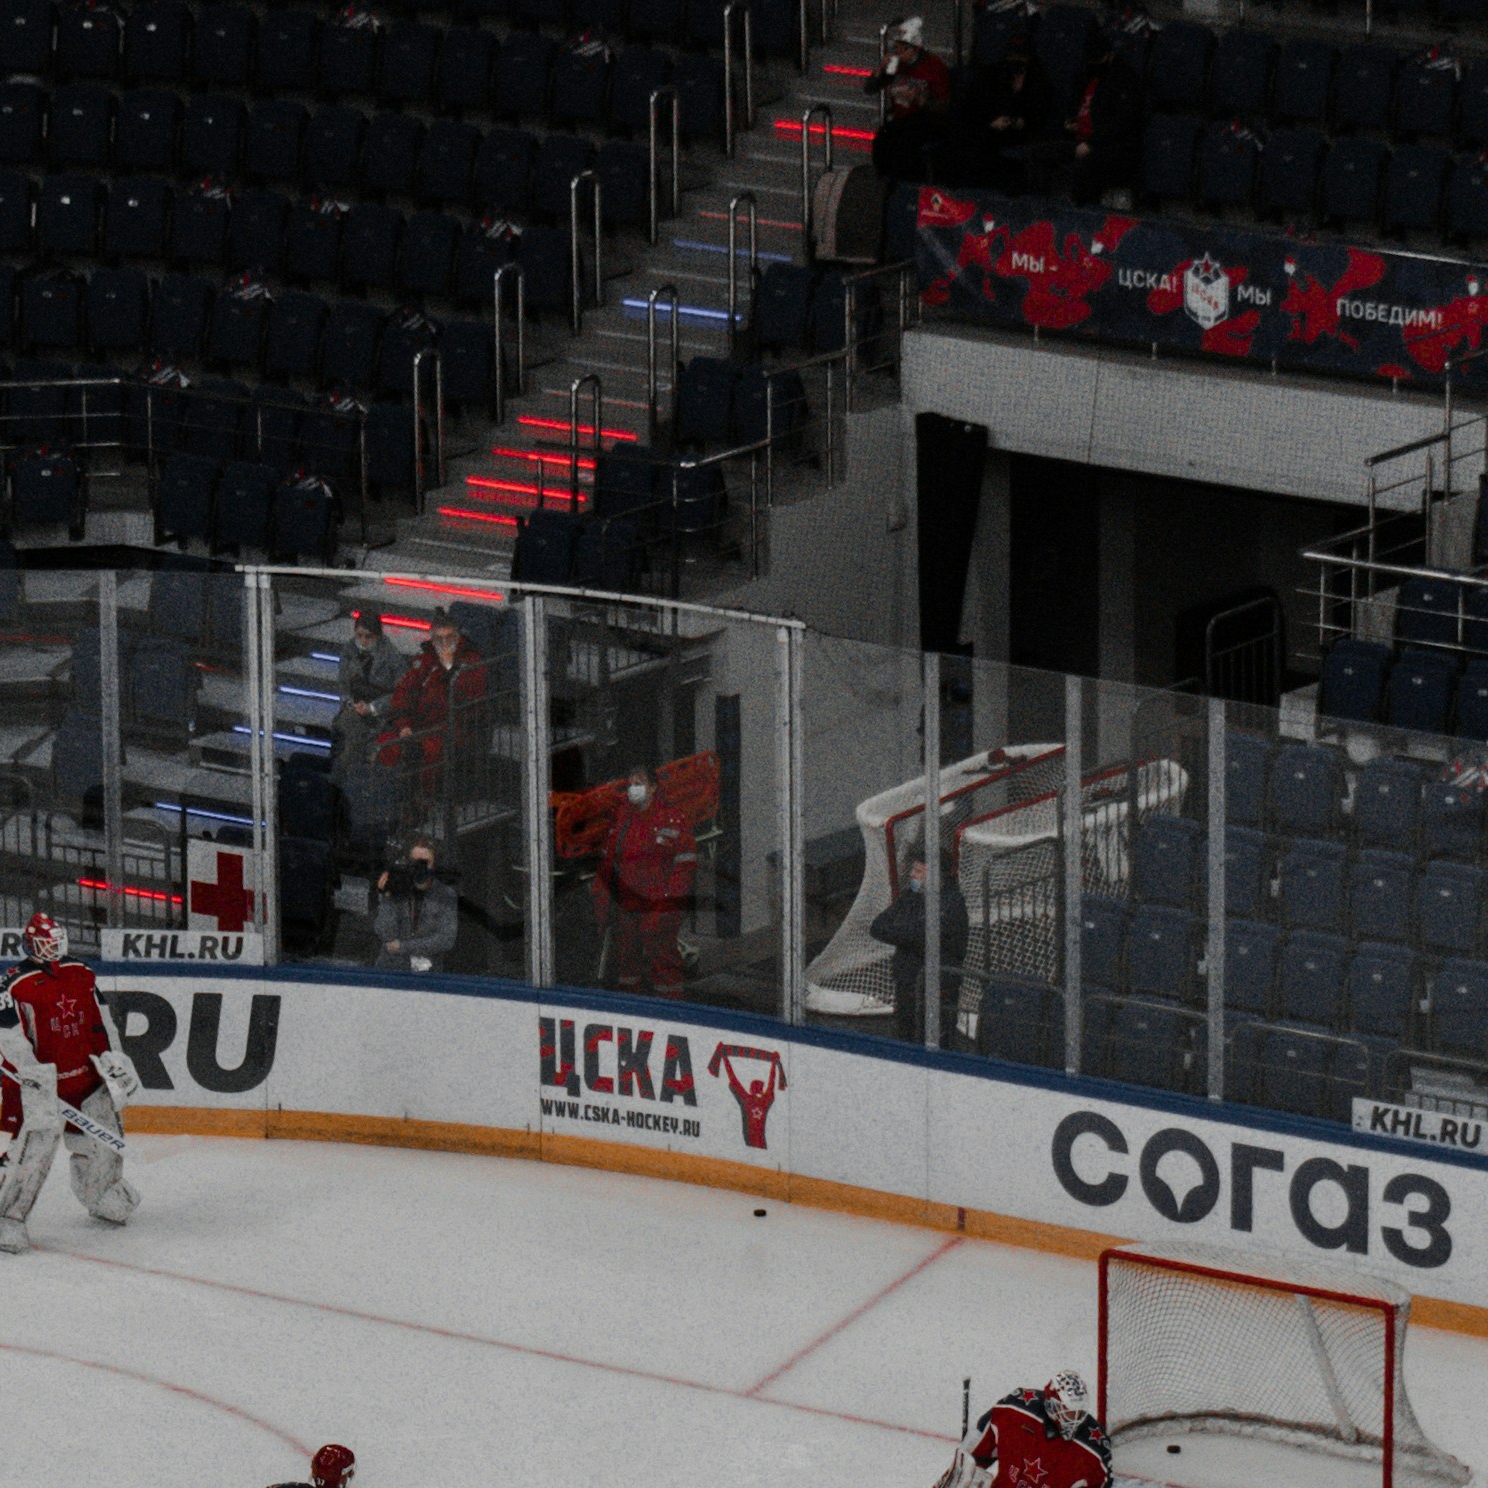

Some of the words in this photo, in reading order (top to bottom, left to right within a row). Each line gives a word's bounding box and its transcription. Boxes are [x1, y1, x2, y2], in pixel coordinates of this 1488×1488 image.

[1011, 252, 1045, 274] МЫ
[1117, 268, 1179, 294] ЦСКА!
[1237, 285, 1272, 306] МЫ
[1336, 298, 1444, 330] ПОБЕДИМ!
[122, 933, 244, 960] KHL.RU
[539, 1016, 698, 1107] ЦСКА
[541, 1098, 701, 1138] WWW.CSKA-HOCKEY.RU
[1370, 1105, 1482, 1149] KHL.RU
